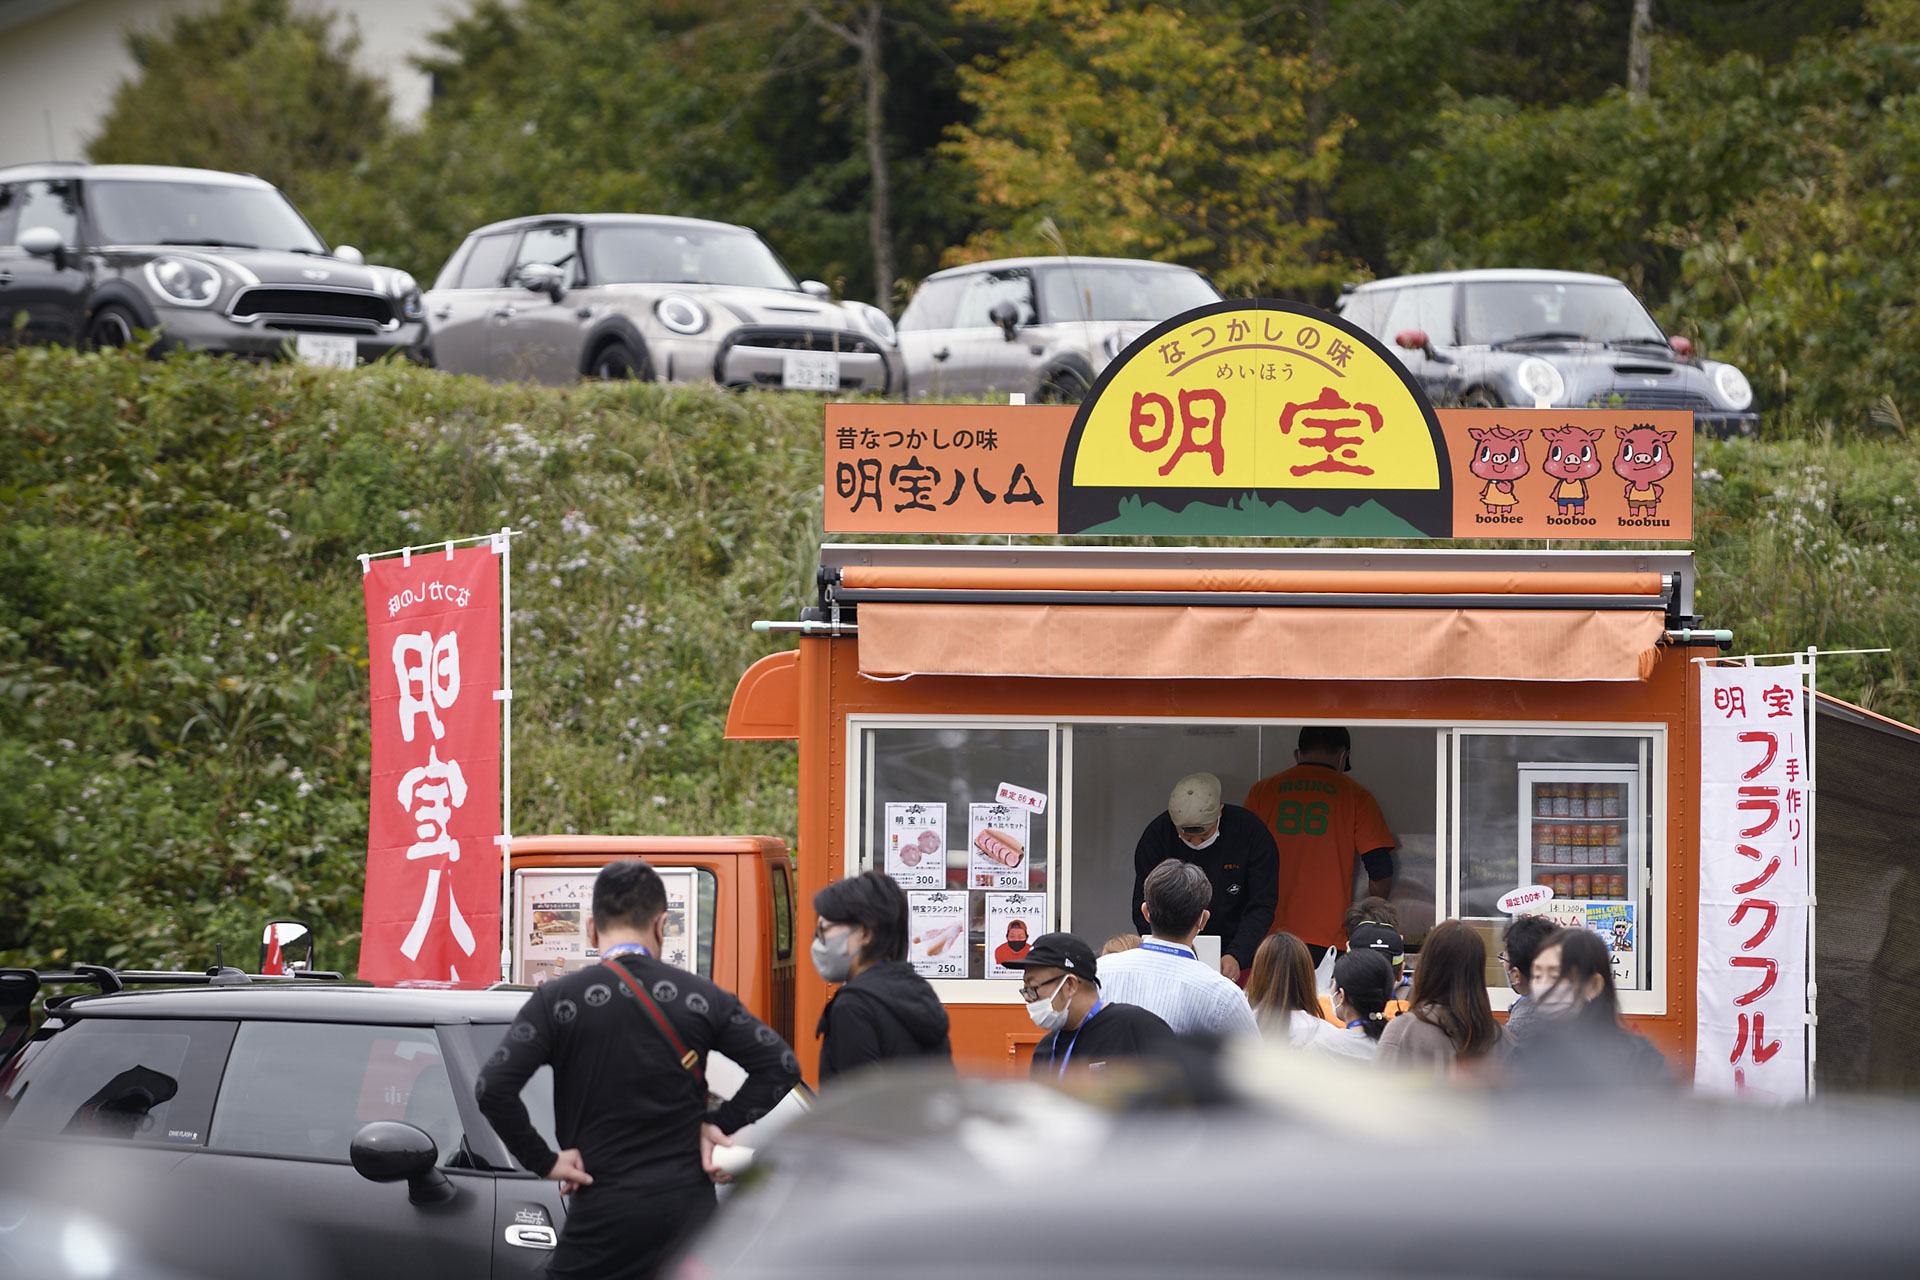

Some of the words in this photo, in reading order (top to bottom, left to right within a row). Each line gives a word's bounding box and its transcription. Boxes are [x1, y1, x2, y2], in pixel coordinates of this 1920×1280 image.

[1158, 317, 1355, 368] なつかしの味
[1216, 363, 1294, 381] めいほう
[836, 427, 999, 451] 昔なつかしの味
[1129, 387, 1384, 477] 明宝
[836, 455, 1045, 513] 明宝ハム
[1475, 513, 1524, 524] boobee
[1546, 515, 1597, 526] booboo
[1617, 517, 1671, 527] boobuu
[1714, 684, 1794, 719] 明宝
[895, 815, 937, 825] 明宝ハム
[1276, 800, 1330, 836] 86
[912, 905, 963, 913] 明宝フランクフルト
[991, 906, 1040, 914] みっくんスマイル
